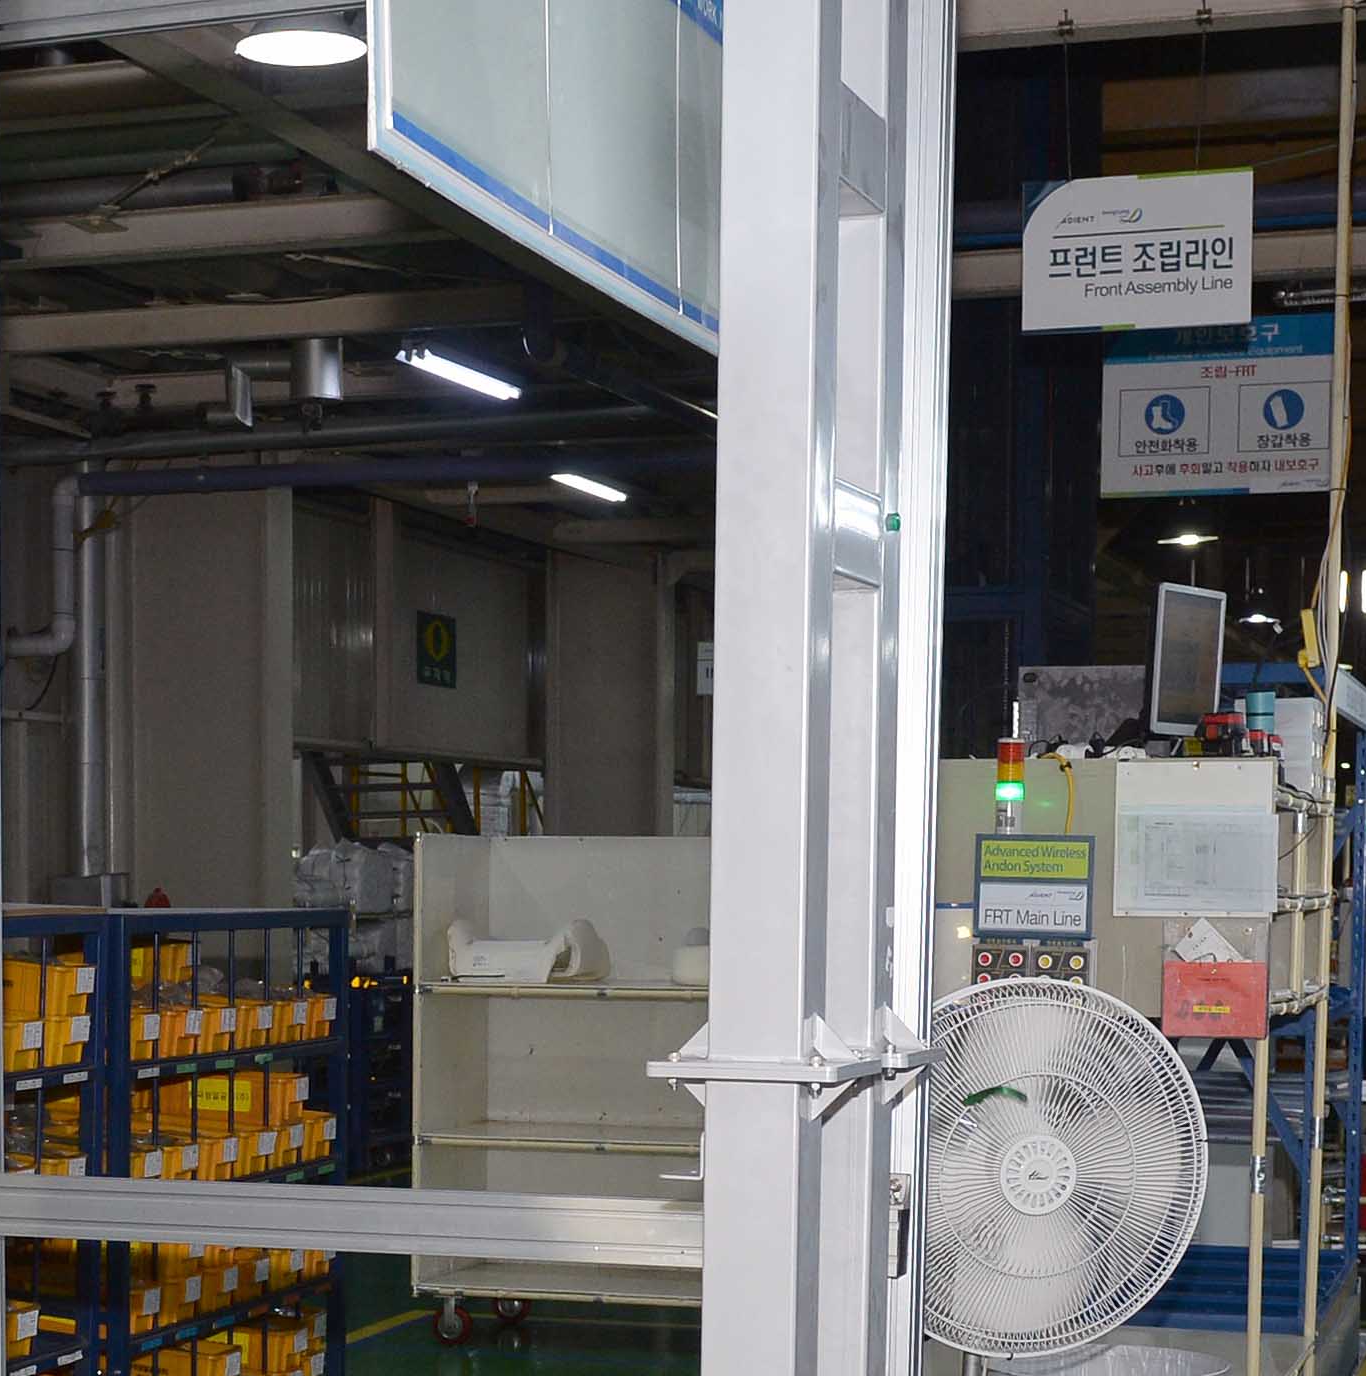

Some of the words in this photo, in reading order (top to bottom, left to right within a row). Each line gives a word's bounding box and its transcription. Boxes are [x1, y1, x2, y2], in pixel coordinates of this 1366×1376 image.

[1048, 245, 1123, 279] 프런트
[1132, 236, 1234, 273] 조립라인
[1084, 282, 1123, 298] Front
[1124, 277, 1199, 296] Assembly
[1201, 275, 1233, 291] Line
[1134, 438, 1200, 454] 안전화착용
[1256, 432, 1312, 449] 장갑착용
[983, 845, 1040, 858] Advanced
[1040, 846, 1087, 859] Wireless
[983, 859, 1022, 872] Andon
[1023, 861, 1064, 875] System
[984, 908, 1012, 924] FRT
[1016, 910, 1049, 926] Main
[1053, 911, 1082, 926] Line
